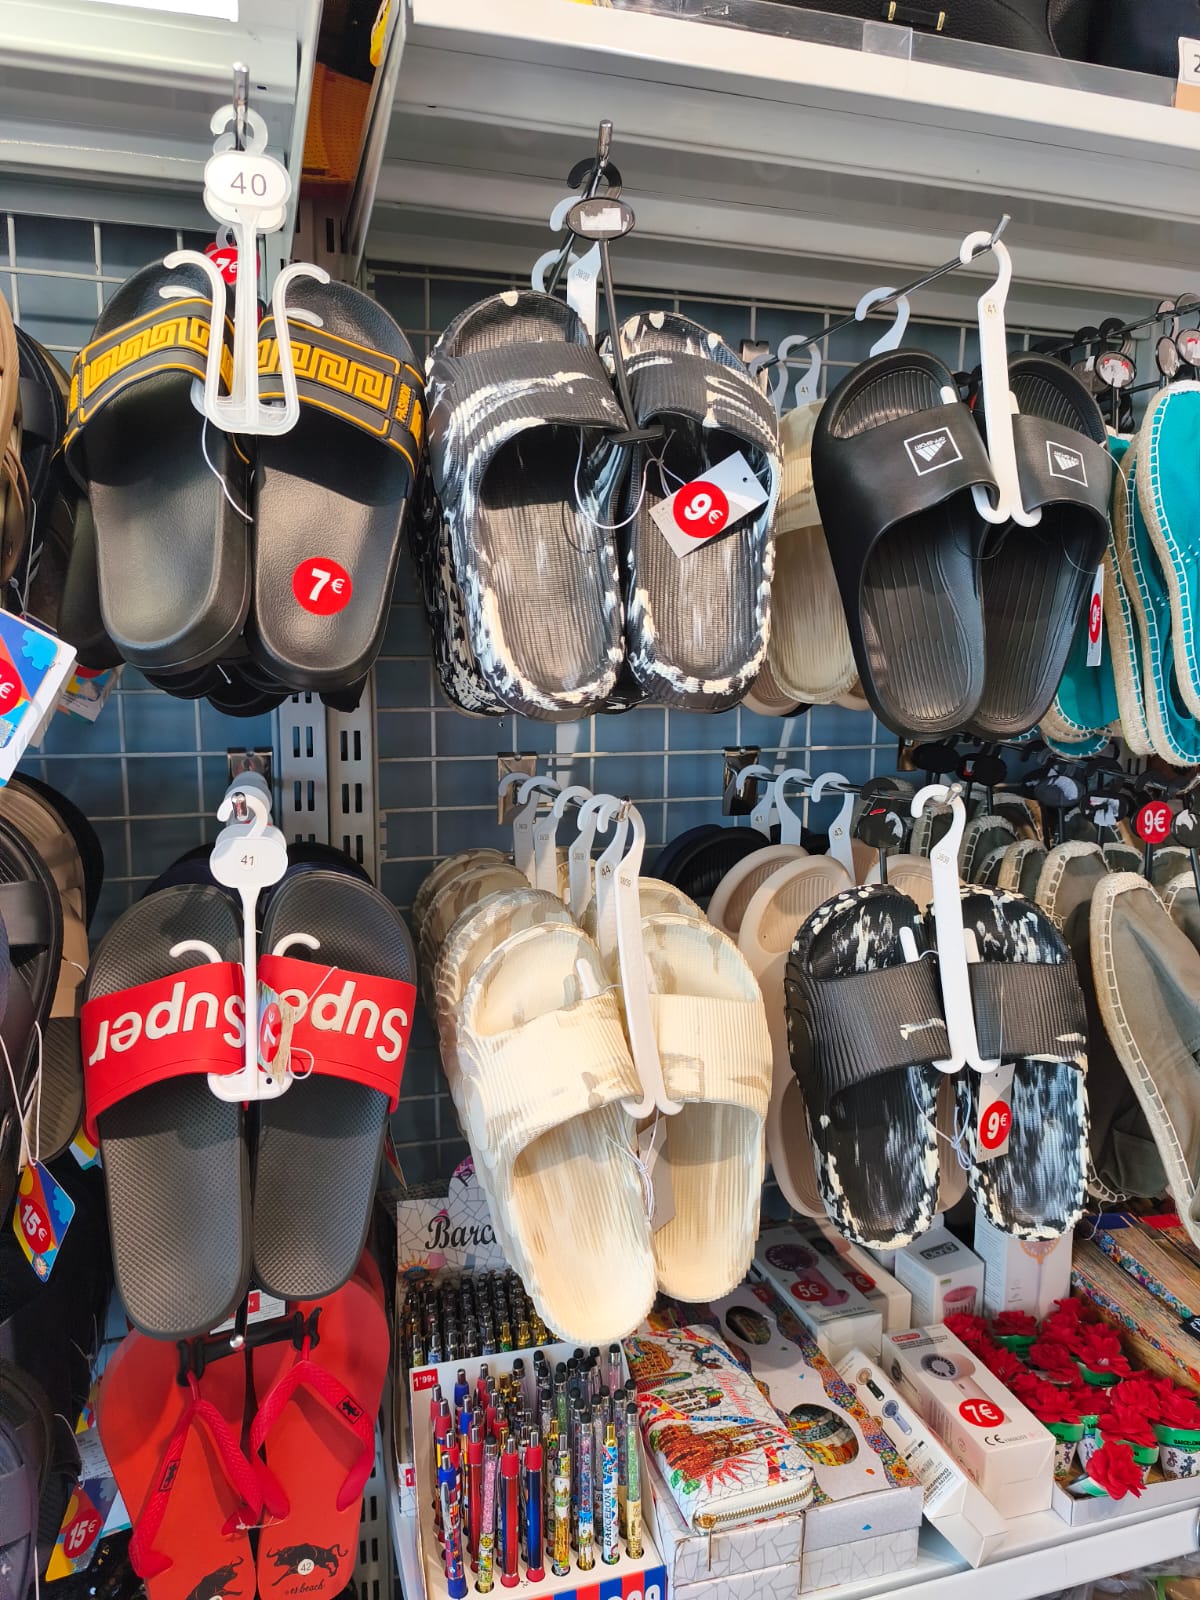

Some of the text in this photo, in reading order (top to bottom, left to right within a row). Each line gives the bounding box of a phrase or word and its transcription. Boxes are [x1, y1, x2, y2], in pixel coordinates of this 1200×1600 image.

[230, 171, 267, 197] 40
[684, 493, 724, 525] 9€
[309, 567, 345, 602] 7€
[1144, 809, 1166, 834] 9€
[240, 855, 254, 866] 41
[600, 865, 611, 877] 44
[89, 981, 246, 1067] Super
[279, 981, 407, 1062] Supe
[987, 1111, 1008, 1140] 9€
[22, 1204, 48, 1241] 15€
[425, 1215, 497, 1249] Barc
[798, 1284, 823, 1297] 5€
[964, 1403, 999, 1423] 7€
[604, 1487, 612, 1547] BARCELONA
[69, 1519, 97, 1550] 15€
[300, 1562, 312, 1572] 42
